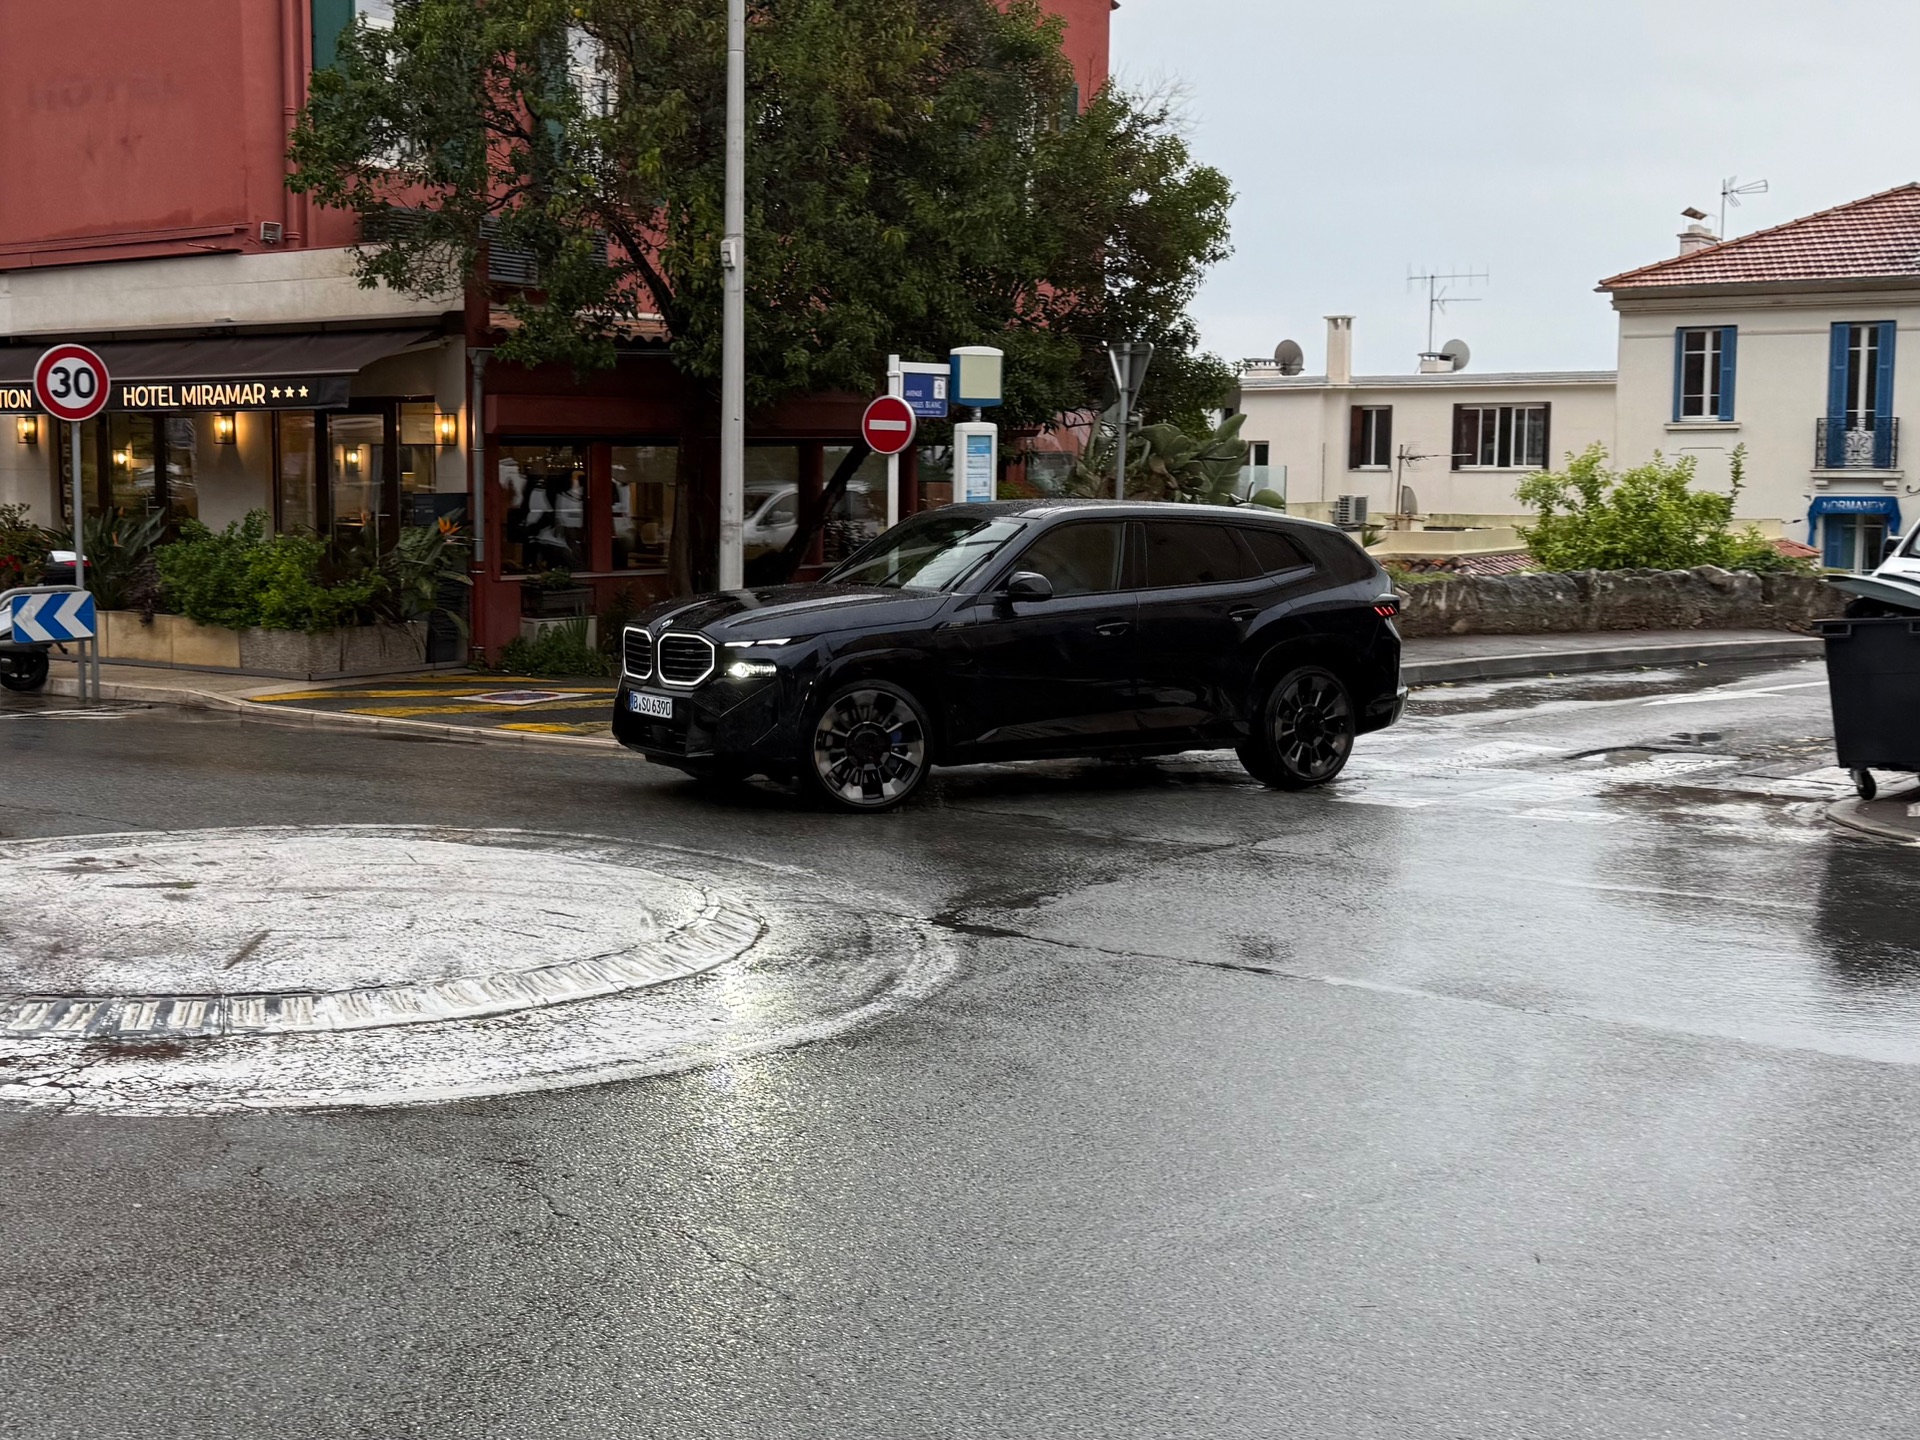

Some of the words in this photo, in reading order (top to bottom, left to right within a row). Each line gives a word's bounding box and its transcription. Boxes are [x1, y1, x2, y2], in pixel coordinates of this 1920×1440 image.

[51, 366, 95, 399] 30
[123, 386, 179, 407] HOTEL
[181, 383, 266, 406] MIRAMAR
[1822, 500, 1887, 510] NORMANDY
